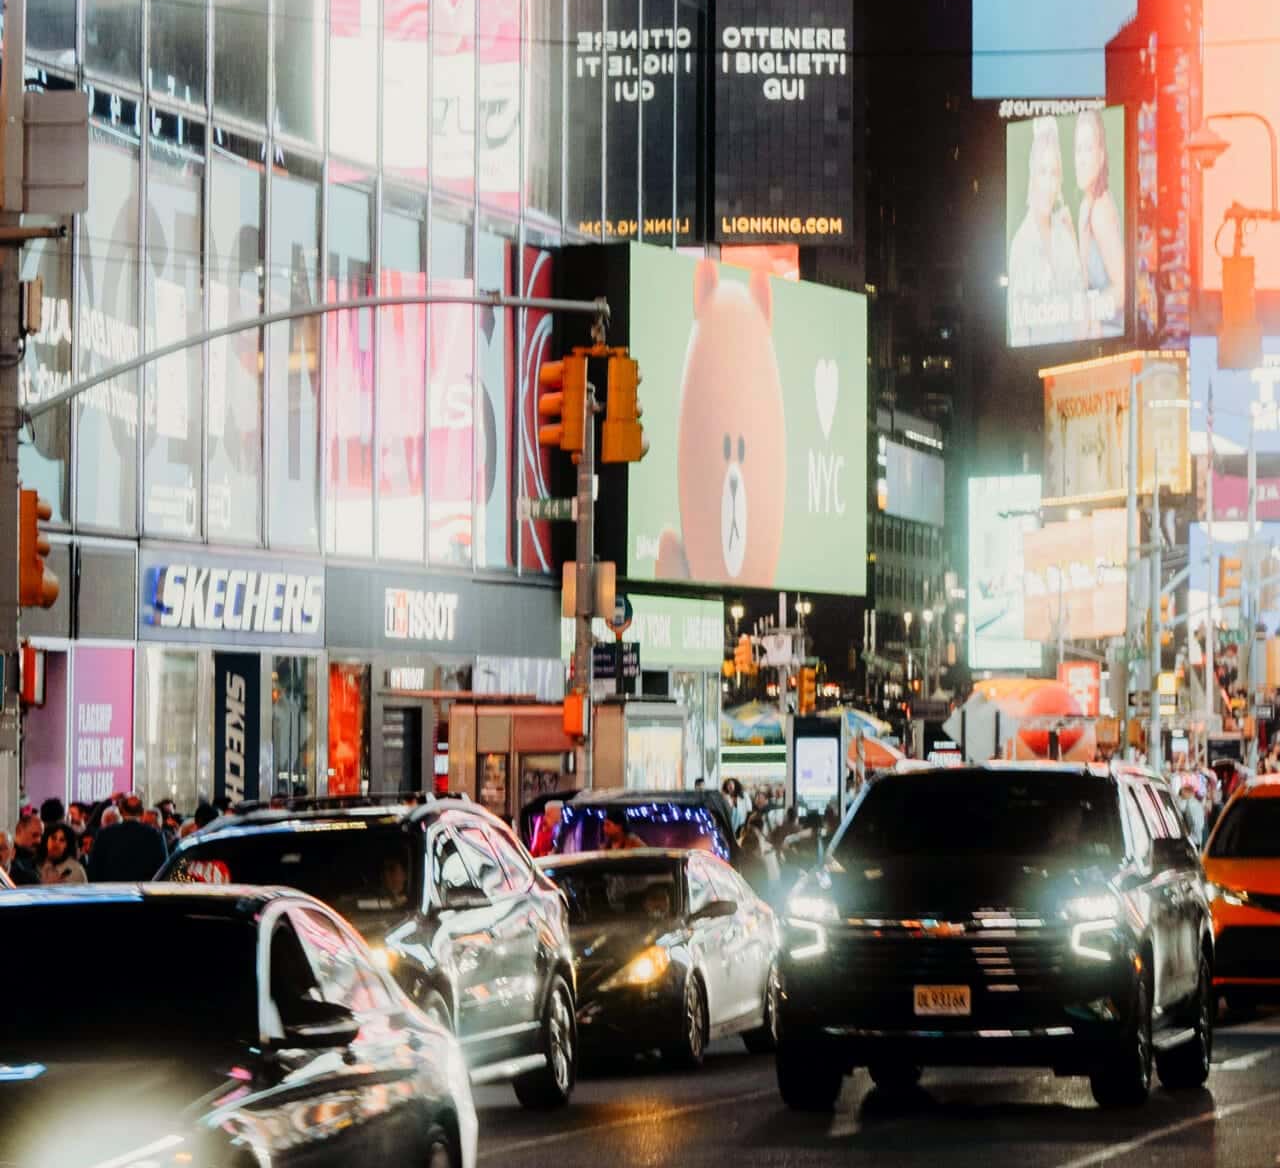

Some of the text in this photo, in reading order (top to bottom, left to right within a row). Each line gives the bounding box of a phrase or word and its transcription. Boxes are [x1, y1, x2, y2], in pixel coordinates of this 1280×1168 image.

[722, 26, 846, 51] OTTENERE
[721, 52, 846, 76] I BIGLIETTI
[763, 78, 805, 101] QUI
[721, 216, 843, 235] LIONKING.COM
[807, 447, 846, 516] NYC
[160, 563, 325, 634] SKECHERS
[78, 736, 124, 768] RETAIL SPACE
[225, 671, 247, 808] SKECH
[78, 772, 114, 801] FOR LEASE
